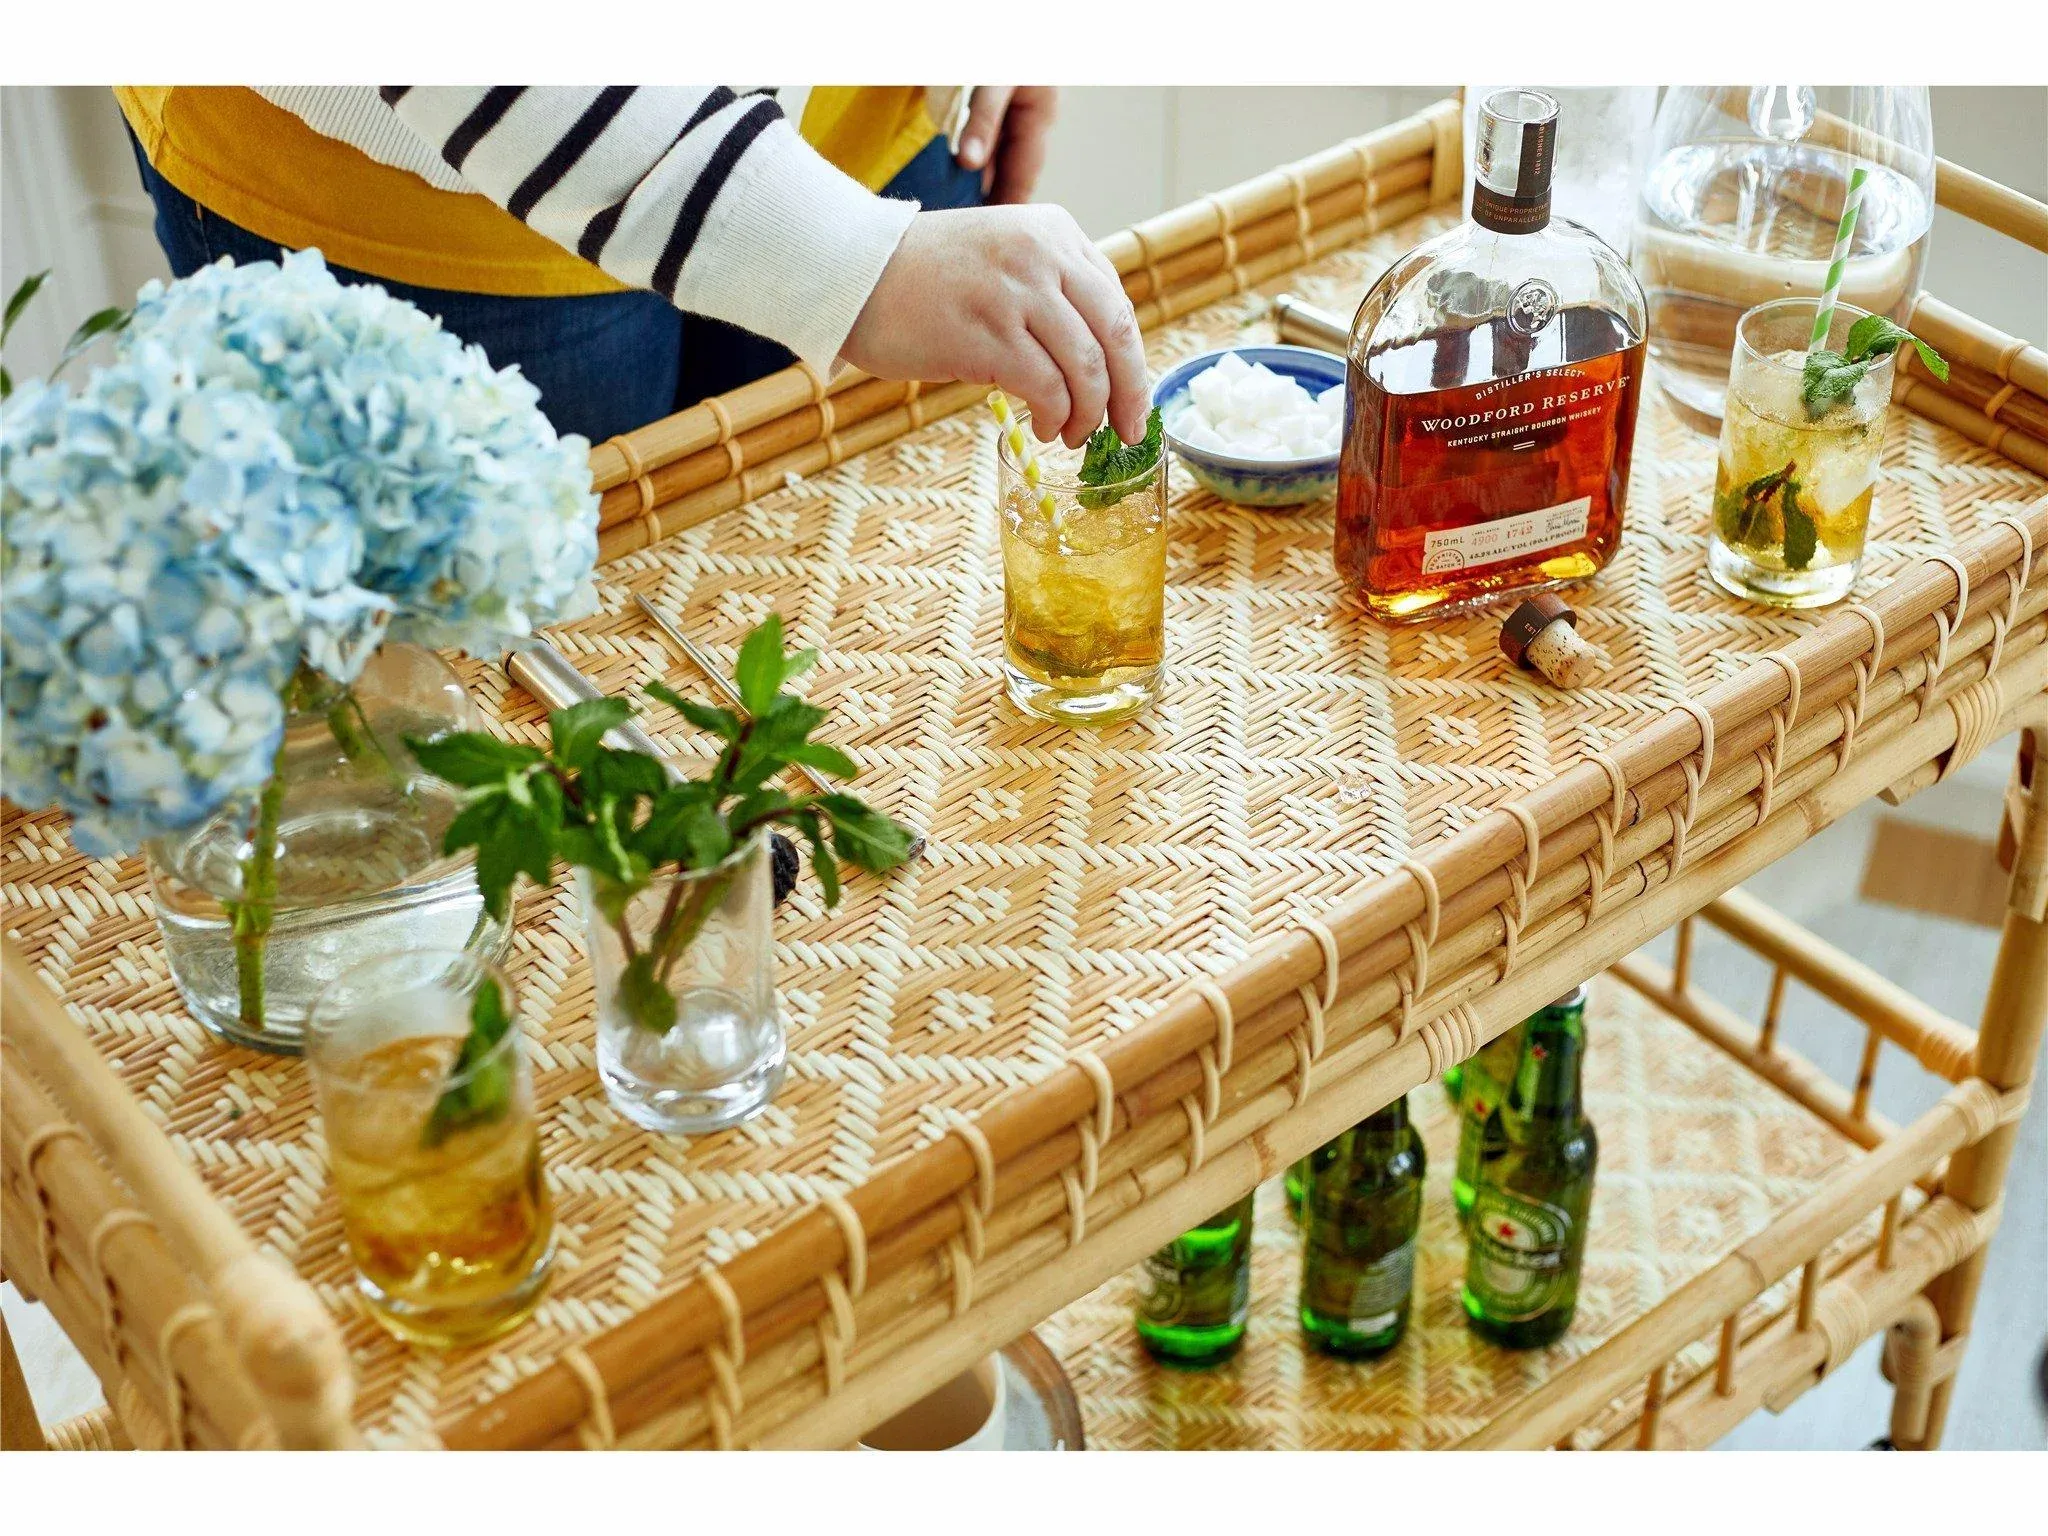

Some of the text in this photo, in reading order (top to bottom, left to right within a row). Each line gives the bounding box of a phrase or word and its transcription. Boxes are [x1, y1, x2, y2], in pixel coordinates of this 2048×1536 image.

[1475, 370, 1541, 401] DISTILLER'S
[1421, 377, 1627, 432] WOODFORD RESERVE
[1447, 406, 1602, 447] KENTUCKY STRAIGHT BOURBON WHISKEY
[1471, 533, 1498, 546] 4900
[1524, 622, 1537, 635] EST
